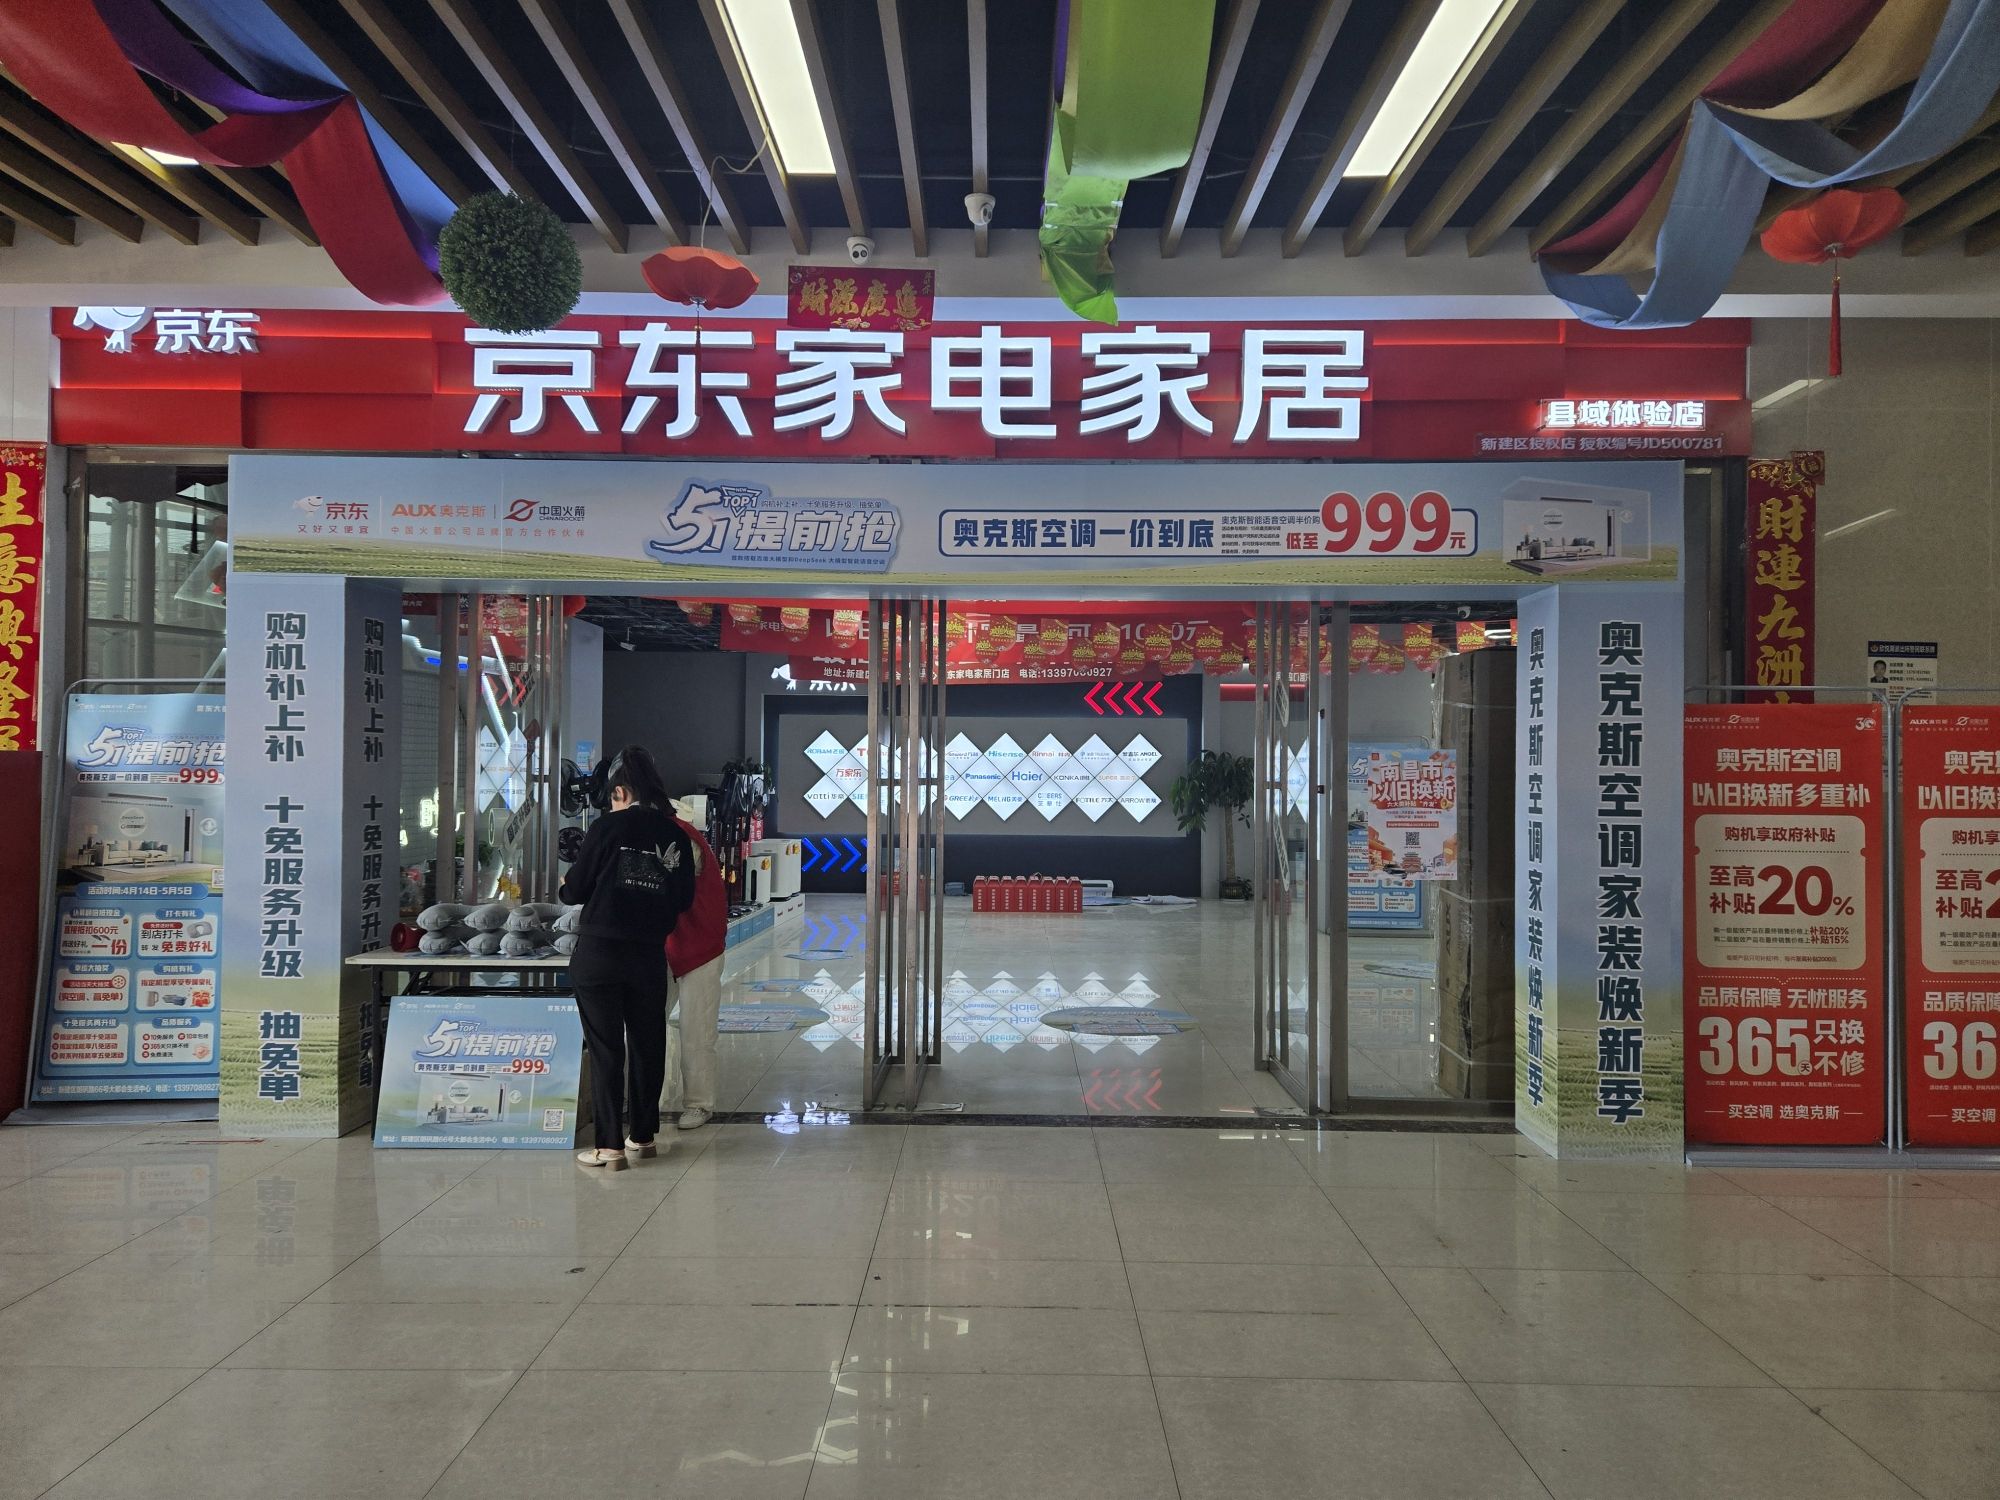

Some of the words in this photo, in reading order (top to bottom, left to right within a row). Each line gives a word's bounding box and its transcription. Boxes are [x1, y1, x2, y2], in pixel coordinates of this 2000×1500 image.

[154, 308, 261, 354] 京东
[463, 323, 1369, 444] 京东家电家居
[1545, 399, 1704, 429] 县域体验店
[326, 502, 370, 520] 京东
[391, 503, 437, 518] AUX
[439, 504, 487, 518] 奥克斯
[538, 505, 586, 516] 中国火箭
[723, 494, 758, 508] TOP1
[297, 524, 370, 535] 又好又便宜
[952, 518, 1215, 548] 奥克斯空调一价到底
[1321, 490, 1452, 554] 999
[264, 610, 307, 763] 购机补上补
[363, 617, 385, 764] 购机补上补
[1379, 760, 1442, 784] 南昌市
[1716, 748, 1842, 773] 奥克斯空调
[179, 767, 219, 784] 999
[834, 768, 863, 778] 万家乐
[1011, 771, 1043, 782] Haier
[1371, 779, 1456, 802] 以旧换新
[1692, 782, 1871, 808] 以旧换新多重补
[1918, 785, 2000, 810] 以旧换
[1724, 826, 1836, 843] 购机享政府补贴
[1528, 627, 1546, 1108] 奥克斯空调家装焕新季
[1596, 620, 1645, 1125] 奥克斯空调家装焕新季
[1709, 864, 1756, 888] 至高
[260, 796, 305, 979] 十免服务升级
[1757, 864, 1855, 917] 20%
[1935, 869, 1983, 892] 至高
[1709, 893, 1756, 915] 补贴
[1935, 896, 1984, 919] 补贴
[141, 930, 184, 940] 到店打卡
[161, 940, 214, 953] 免费好礼
[1698, 986, 1782, 1008] 品质保障
[1786, 988, 1868, 1009] 无忧服务
[1812, 1019, 1866, 1045] 只换
[258, 1009, 302, 1101] 抽免单
[512, 1058, 545, 1074] 999
[1813, 1050, 1866, 1077] 不修
[1728, 1104, 1774, 1120] 买空调
[1779, 1104, 1840, 1120] 选奥克斯
[1950, 1108, 1997, 1124] 买空调
